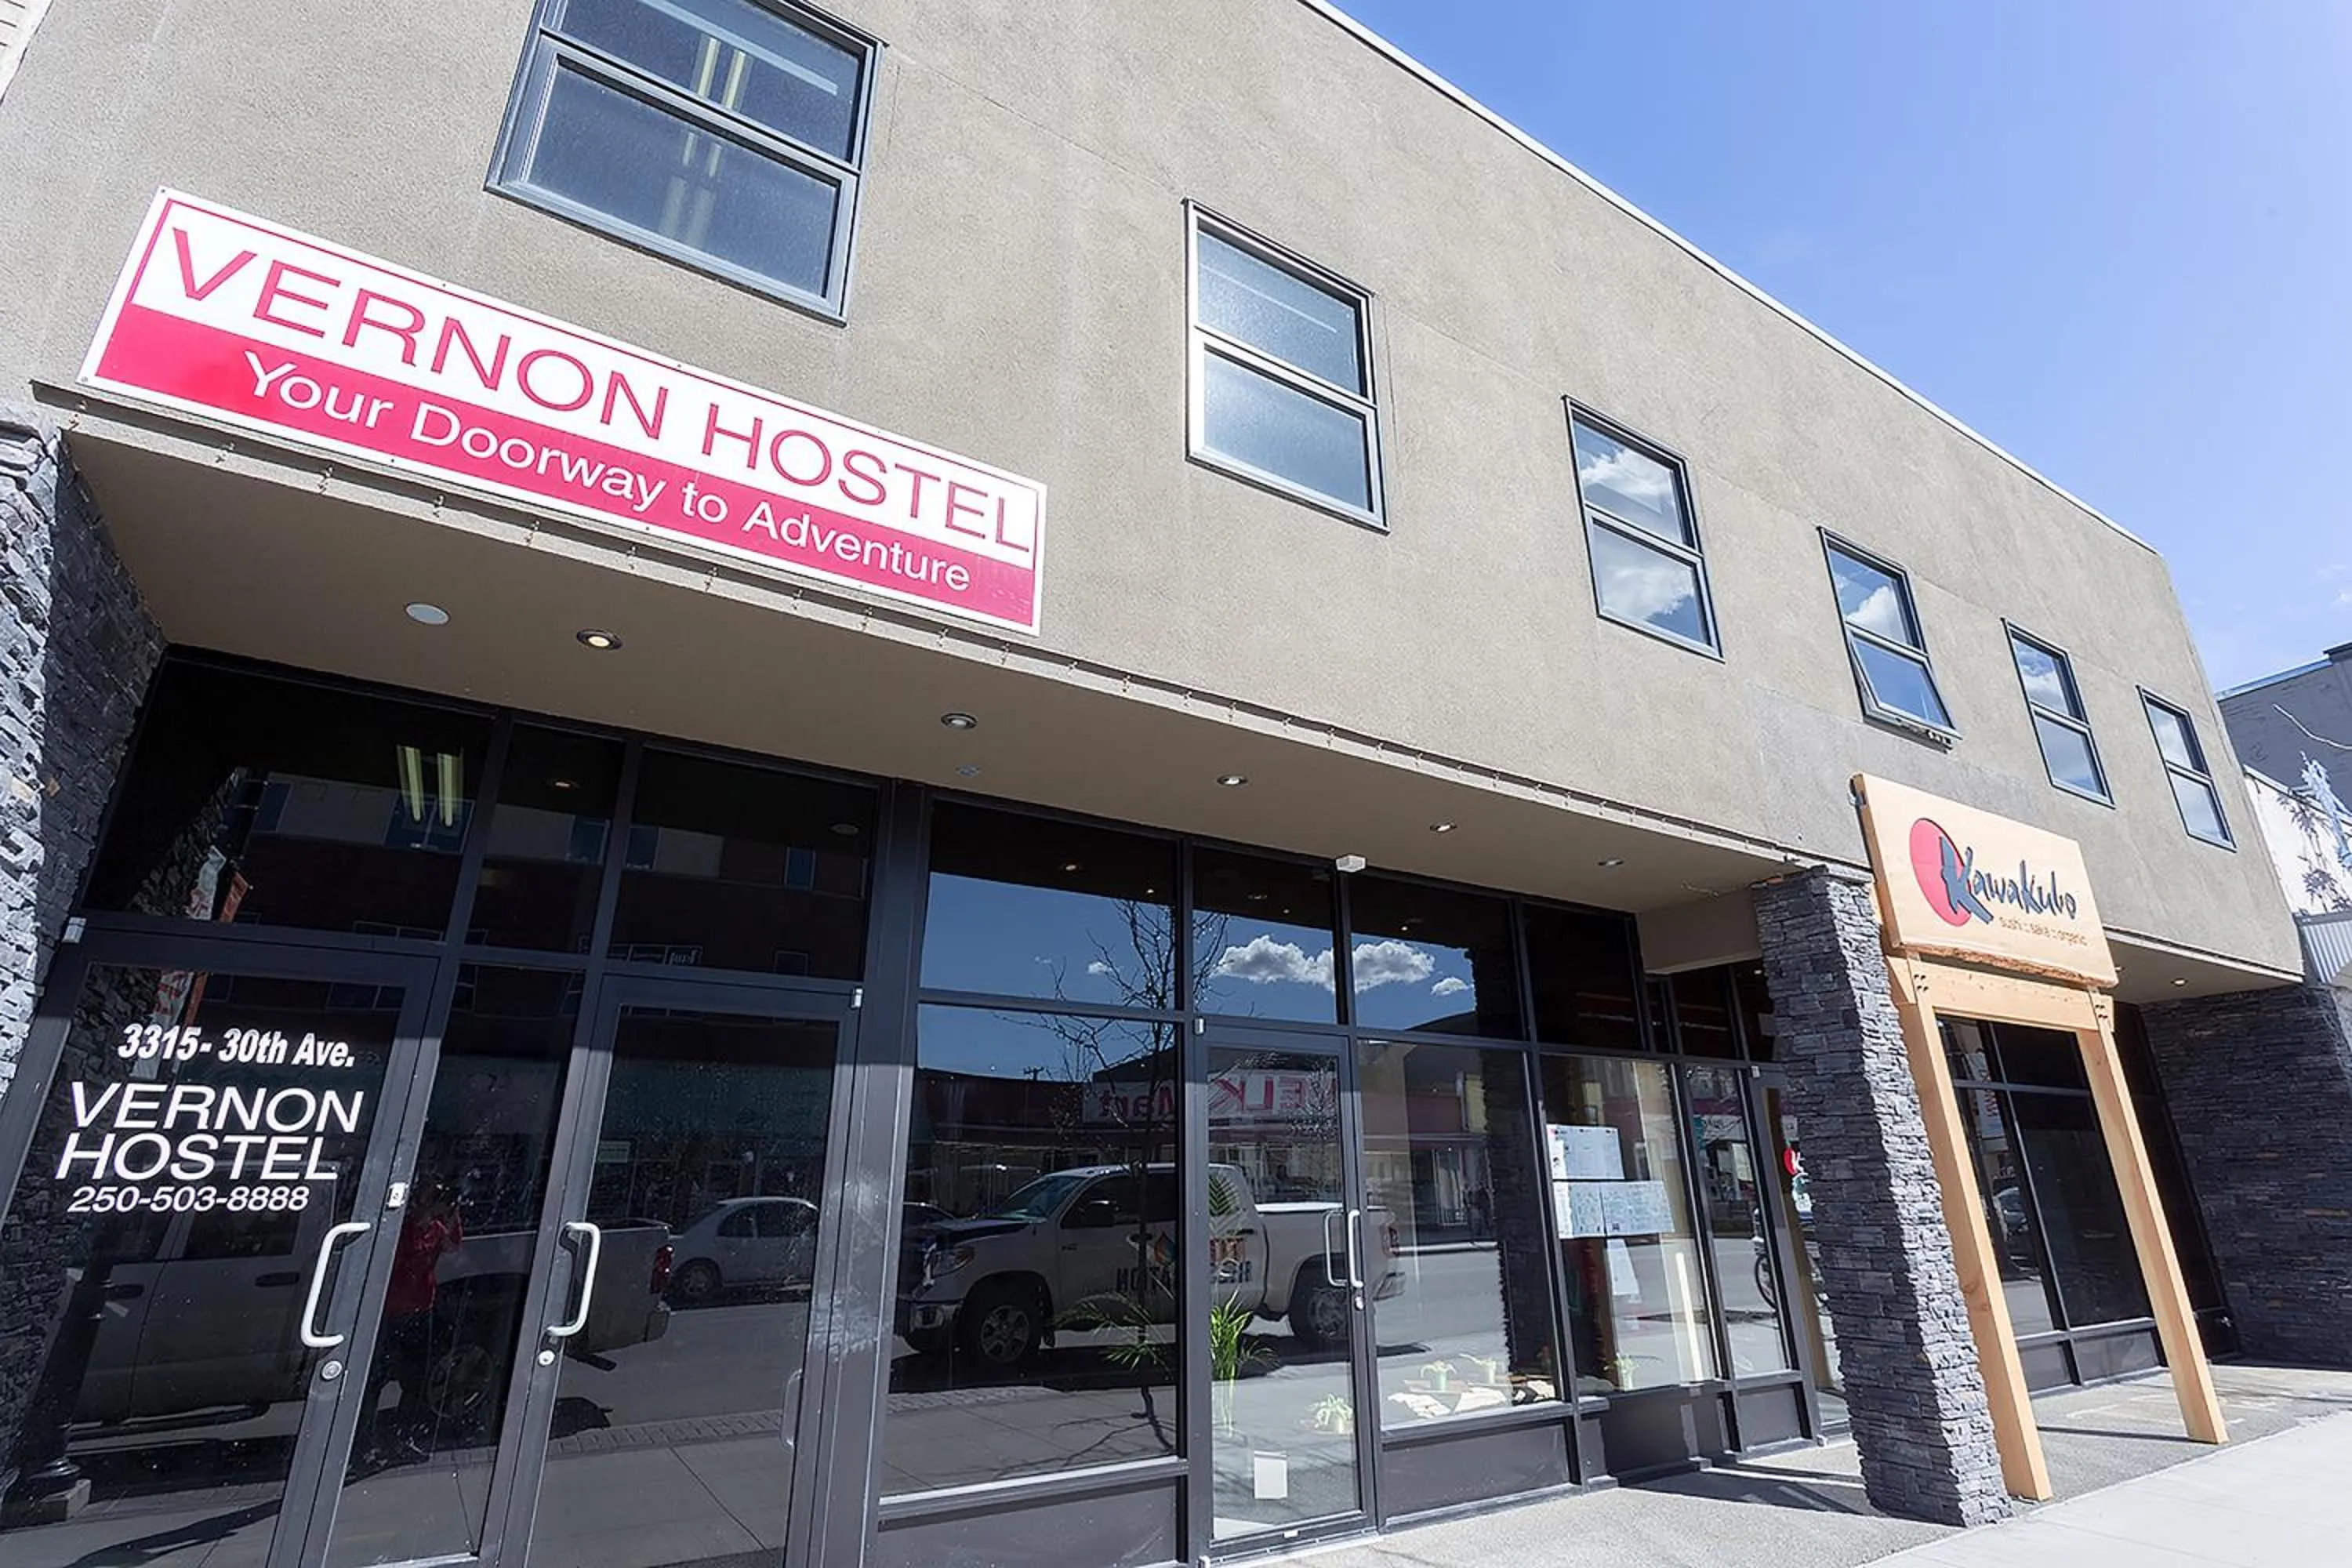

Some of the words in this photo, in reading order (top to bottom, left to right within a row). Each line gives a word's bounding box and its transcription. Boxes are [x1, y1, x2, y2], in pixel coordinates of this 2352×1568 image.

[172, 227, 669, 440] VERNON
[702, 402, 1030, 553] HOSTEL
[243, 350, 394, 429] Your
[410, 401, 666, 511] Doorway
[681, 479, 728, 523] to
[742, 501, 971, 592] Adventure
[1939, 836, 2078, 925] Kawakubo
[118, 1023, 212, 1061] 3315-
[218, 1028, 289, 1065] 30th
[292, 1033, 356, 1068] Ave.
[71, 1081, 365, 1134] VERNON
[54, 1132, 339, 1181] HOSTEL
[67, 1185, 310, 1213] 250-503-8888
